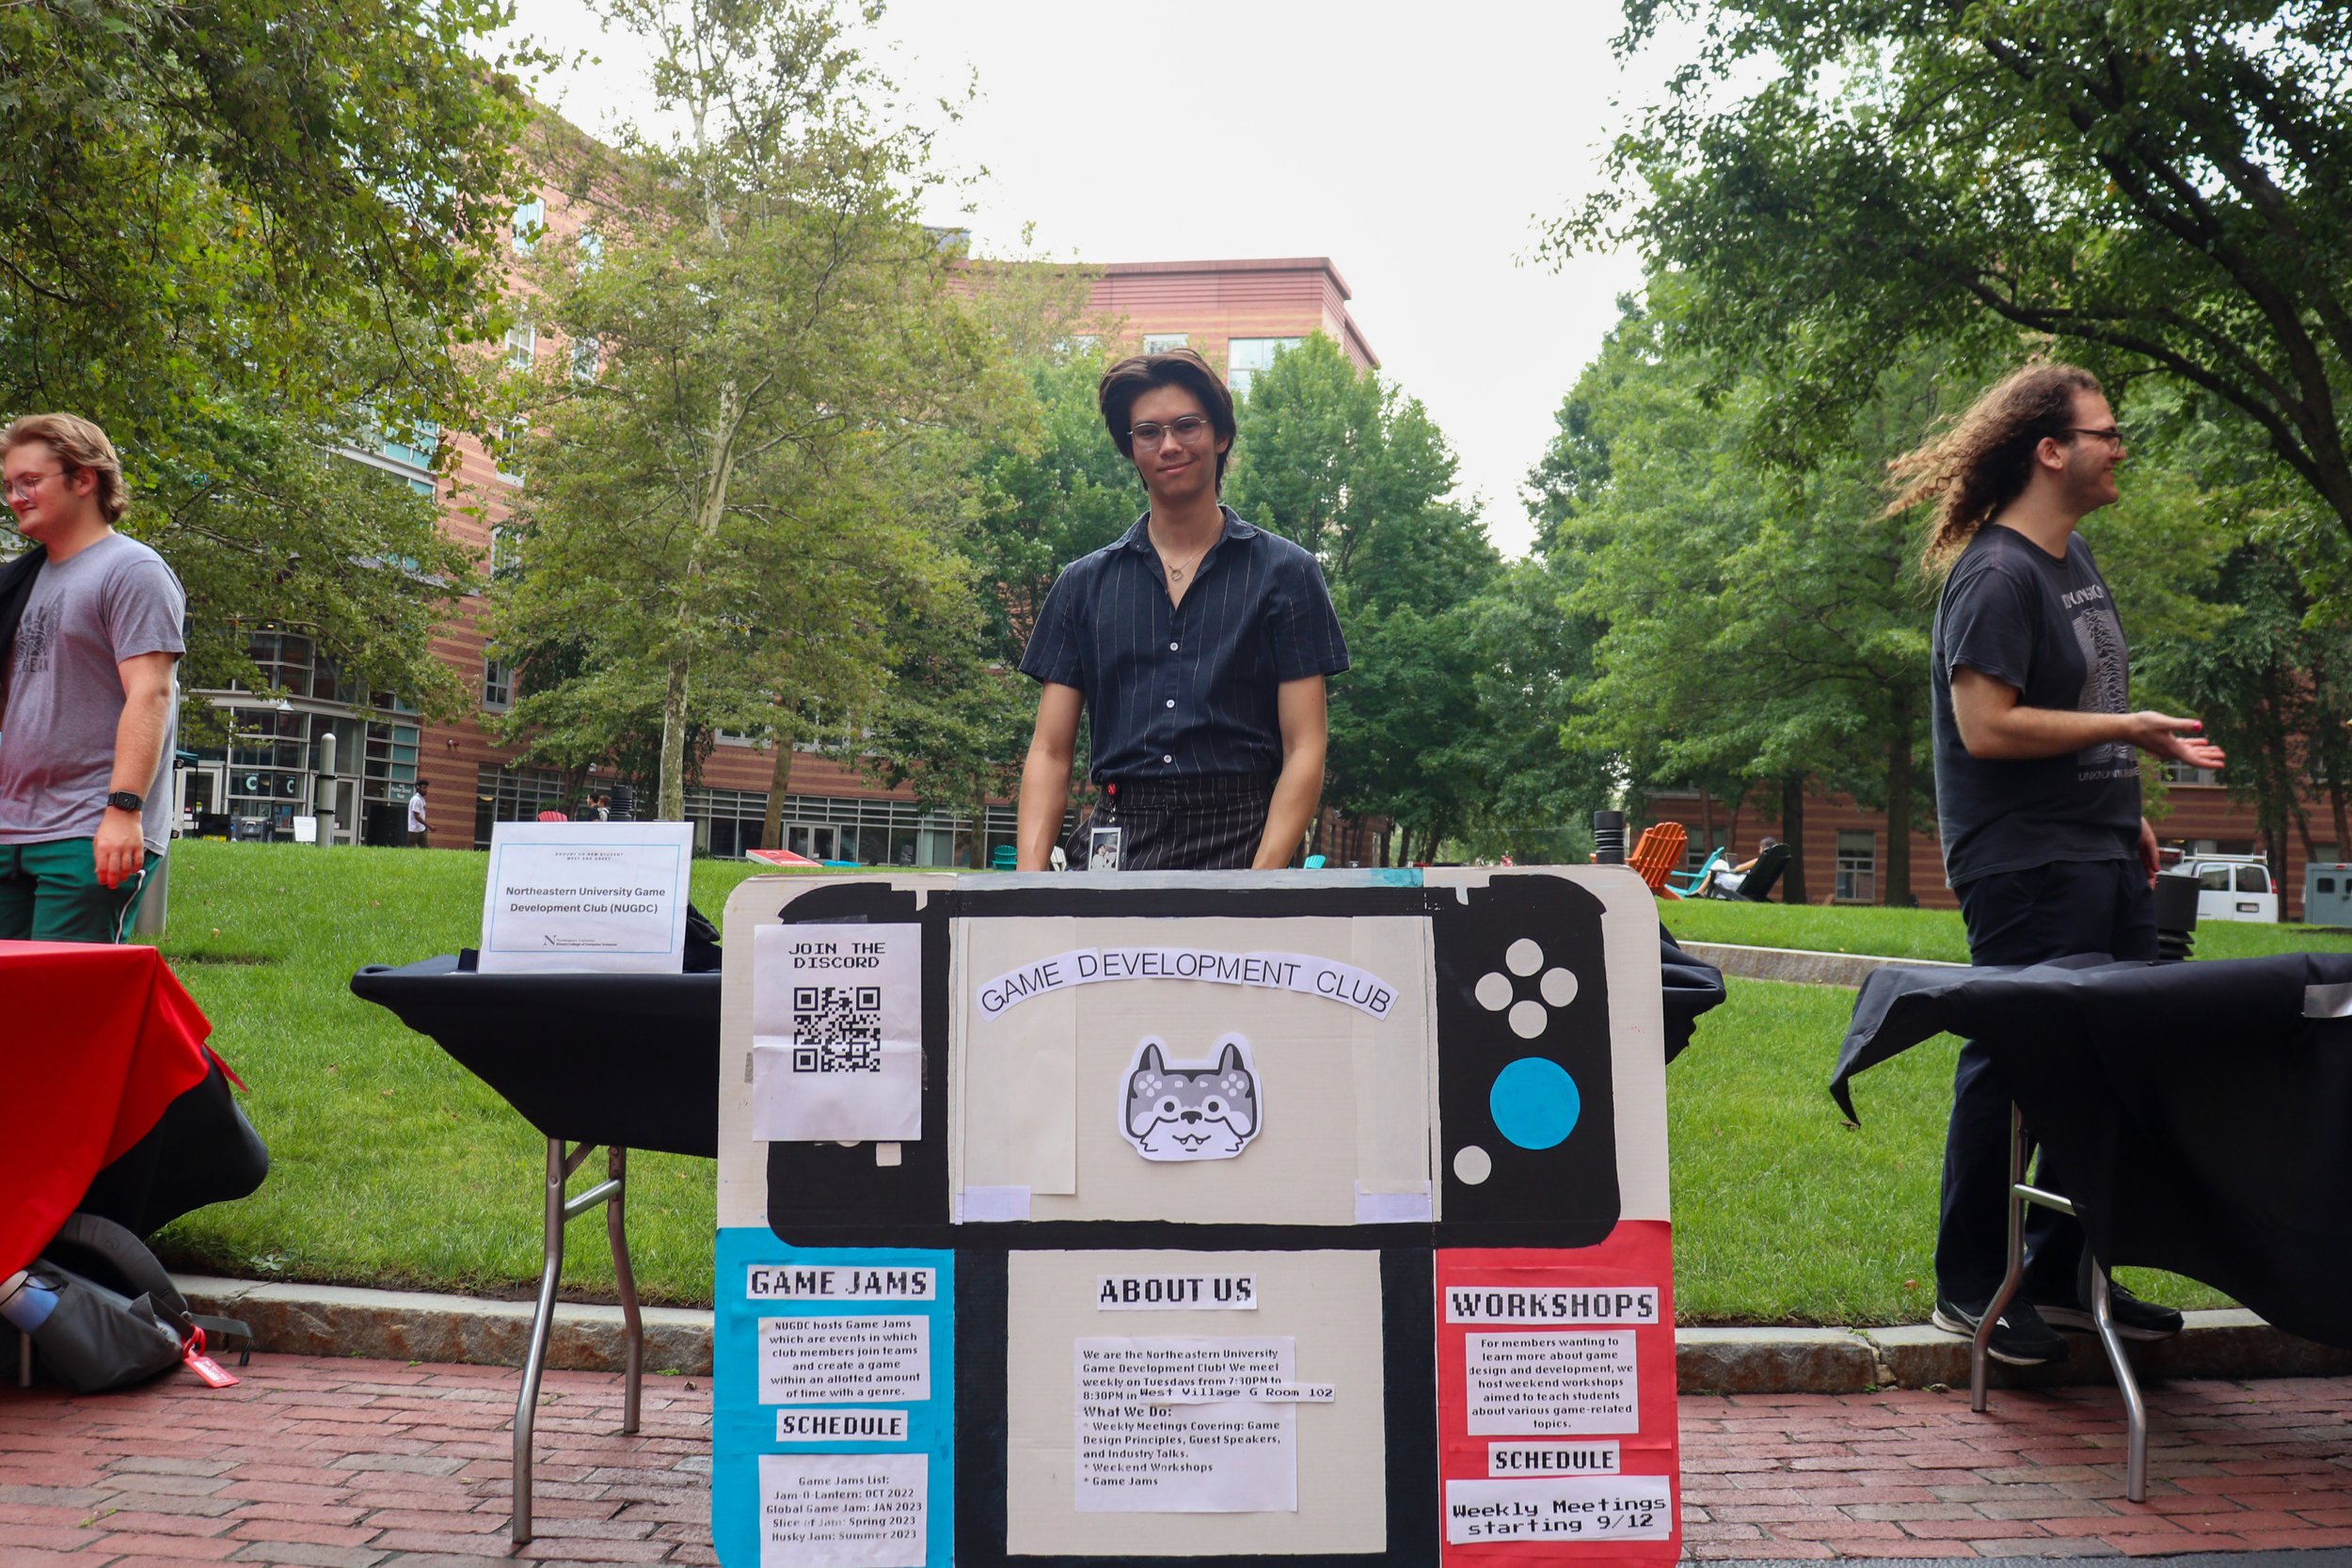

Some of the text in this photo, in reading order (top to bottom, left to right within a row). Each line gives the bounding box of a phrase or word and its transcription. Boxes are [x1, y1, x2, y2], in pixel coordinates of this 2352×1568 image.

[505, 886, 665, 898] Northeastern University Game
[510, 903, 658, 914] Development Club (NUGDC)
[788, 942, 886, 955] JOIN THE
[794, 957, 880, 969] DISCORD
[981, 952, 1391, 1014] GAME DEVELOPMENT CLUB
[752, 1271, 927, 1295] GAME JAMS
[1101, 1277, 1251, 1303] ABOUT US
[1453, 1293, 1652, 1318] WORKSHOPS
[775, 1320, 912, 1330] NUGDC hosts Game Jams
[770, 1333, 917, 1344] which are events in which
[1481, 1338, 1619, 1348] For members wanting to
[772, 1346, 918, 1357] club members join teams
[1083, 1348, 1279, 1360] We are the Northeastern University
[1482, 1352, 1618, 1362] learn more about game
[792, 1361, 814, 1370] and
[818, 1361, 854, 1370] create
[867, 1361, 901, 1370] game
[1083, 1362, 1279, 1374] Game Development Club! We meet
[1469, 1366, 1507, 1377] design
[1510, 1366, 1532, 1374] and
[1535, 1365, 1614, 1376] development,
[770, 1373, 920, 1386] within an allotted amount
[1082, 1377, 1124, 1388] weekly
[1126, 1377, 1141, 1386] on
[1143, 1376, 1196, 1386] Tuesdays
[1198, 1376, 1226, 1386] from
[1270, 1375, 1281, 1384] to
[1478, 1378, 1624, 1388] host weekend workshops
[786, 1388, 798, 1399] of
[801, 1389, 827, 1398] time
[829, 1388, 854, 1398] with
[867, 1387, 905, 1398] genre.
[1083, 1386, 1333, 1401] 8:30PM in West Village G Room 102
[1483, 1391, 1620, 1402] aimed to teach students
[1083, 1405, 1172, 1418] What We Do:
[1471, 1404, 1632, 1417] about various game-related
[783, 1416, 902, 1436] SCHEDULE
[1092, 1420, 1280, 1433] Weekly Meetings Covering: Game
[1534, 1419, 1571, 1431] topics.
[1083, 1433, 1281, 1447] Design Principles, Guest Speakers,
[1083, 1449, 1189, 1460] and Industry Talks.
[1496, 1450, 1613, 1469] SCHEDULE
[1092, 1463, 1214, 1473] Weekend Workshops
[799, 1475, 889, 1486] Game Jams List:
[1092, 1476, 1158, 1486] Game Jams
[865, 1489, 884, 1498] OCT
[887, 1488, 914, 1498] 2022
[766, 1502, 922, 1514] Global Game Jam: JAN 2023
[1453, 1497, 1667, 1518] Weekly Meetings
[772, 1518, 800, 1528] Slice
[849, 1517, 886, 1528] Spring
[889, 1516, 916, 1526] 2023
[1468, 1513, 1653, 1536] starting 9/12
[771, 1529, 916, 1543] Husky Jam: Summer 2023
